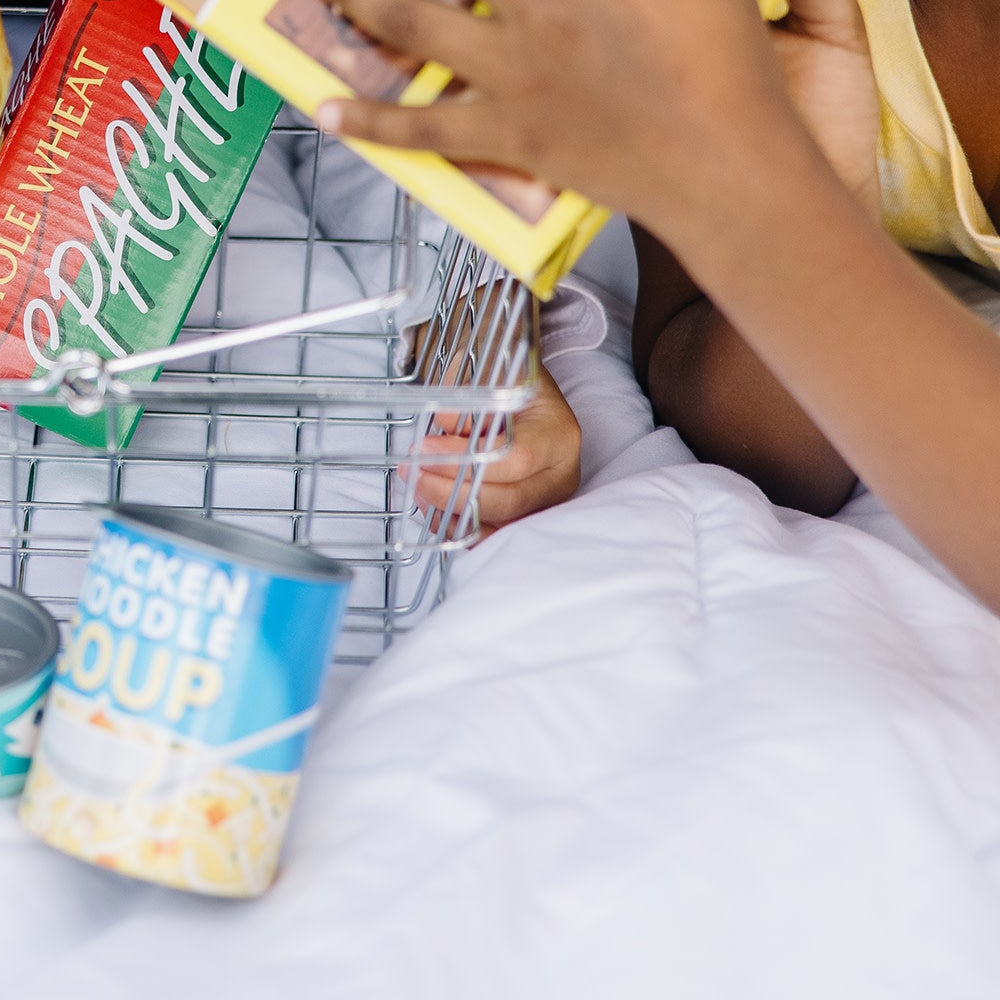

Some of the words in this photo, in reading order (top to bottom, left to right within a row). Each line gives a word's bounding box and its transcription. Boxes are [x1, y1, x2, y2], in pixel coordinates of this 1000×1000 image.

[18, 45, 110, 193] WHEAT
[23, 4, 244, 370] SPAGHE
[83, 576, 238, 660] OODLE
[91, 534, 250, 617] HICKEN
